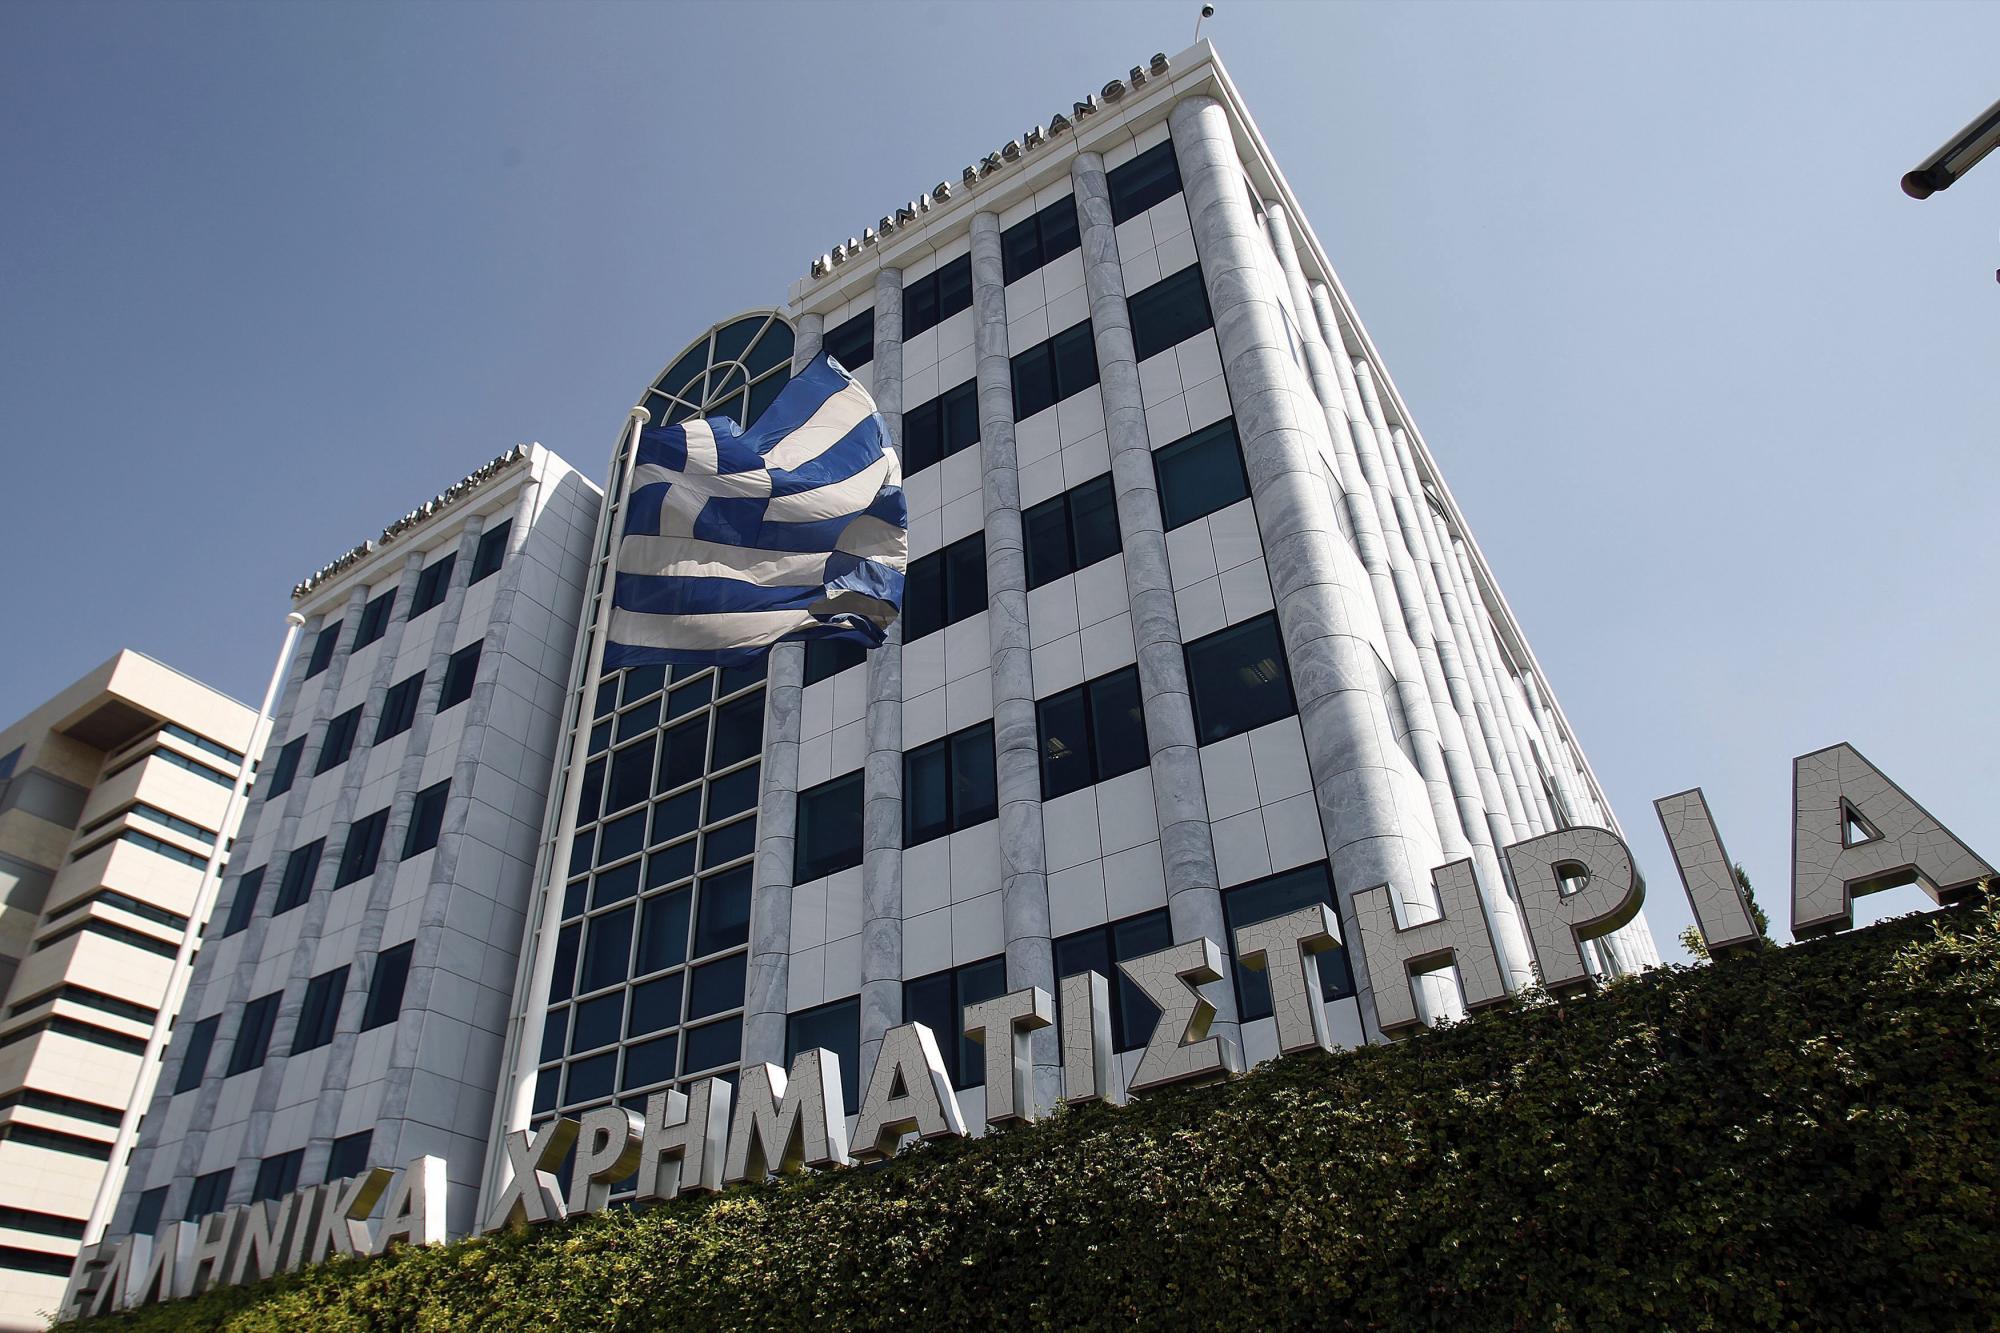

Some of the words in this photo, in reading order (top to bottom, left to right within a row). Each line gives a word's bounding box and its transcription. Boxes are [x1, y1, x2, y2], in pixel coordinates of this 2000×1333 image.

[811, 180, 952, 280] HELLENIC
[962, 52, 1170, 189] EXCHANGES
[57, 1154, 447, 1323] ΕΛΛΗΝΙΚΑ
[484, 741, 1999, 1234] ΧΡΗΜΑΤΙΣΤΗΡΙΑ
